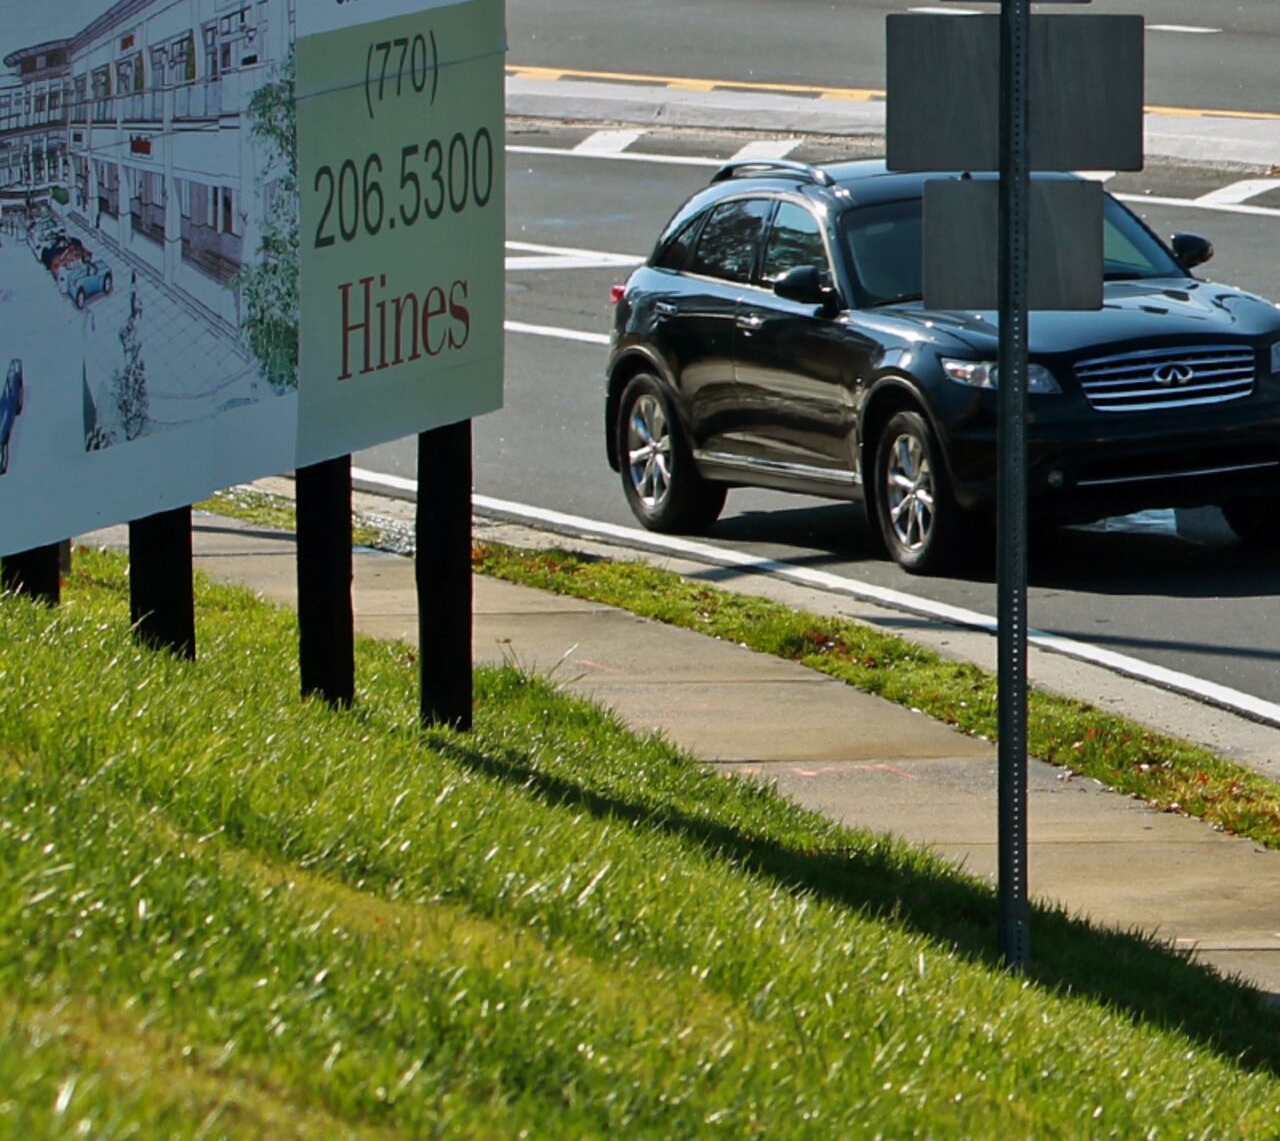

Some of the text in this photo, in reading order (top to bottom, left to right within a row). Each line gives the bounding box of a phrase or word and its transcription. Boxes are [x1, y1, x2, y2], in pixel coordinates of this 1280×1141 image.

[365, 29, 438, 119] (770)
[314, 126, 493, 249] 206.5300
[337, 273, 470, 381] Hines
